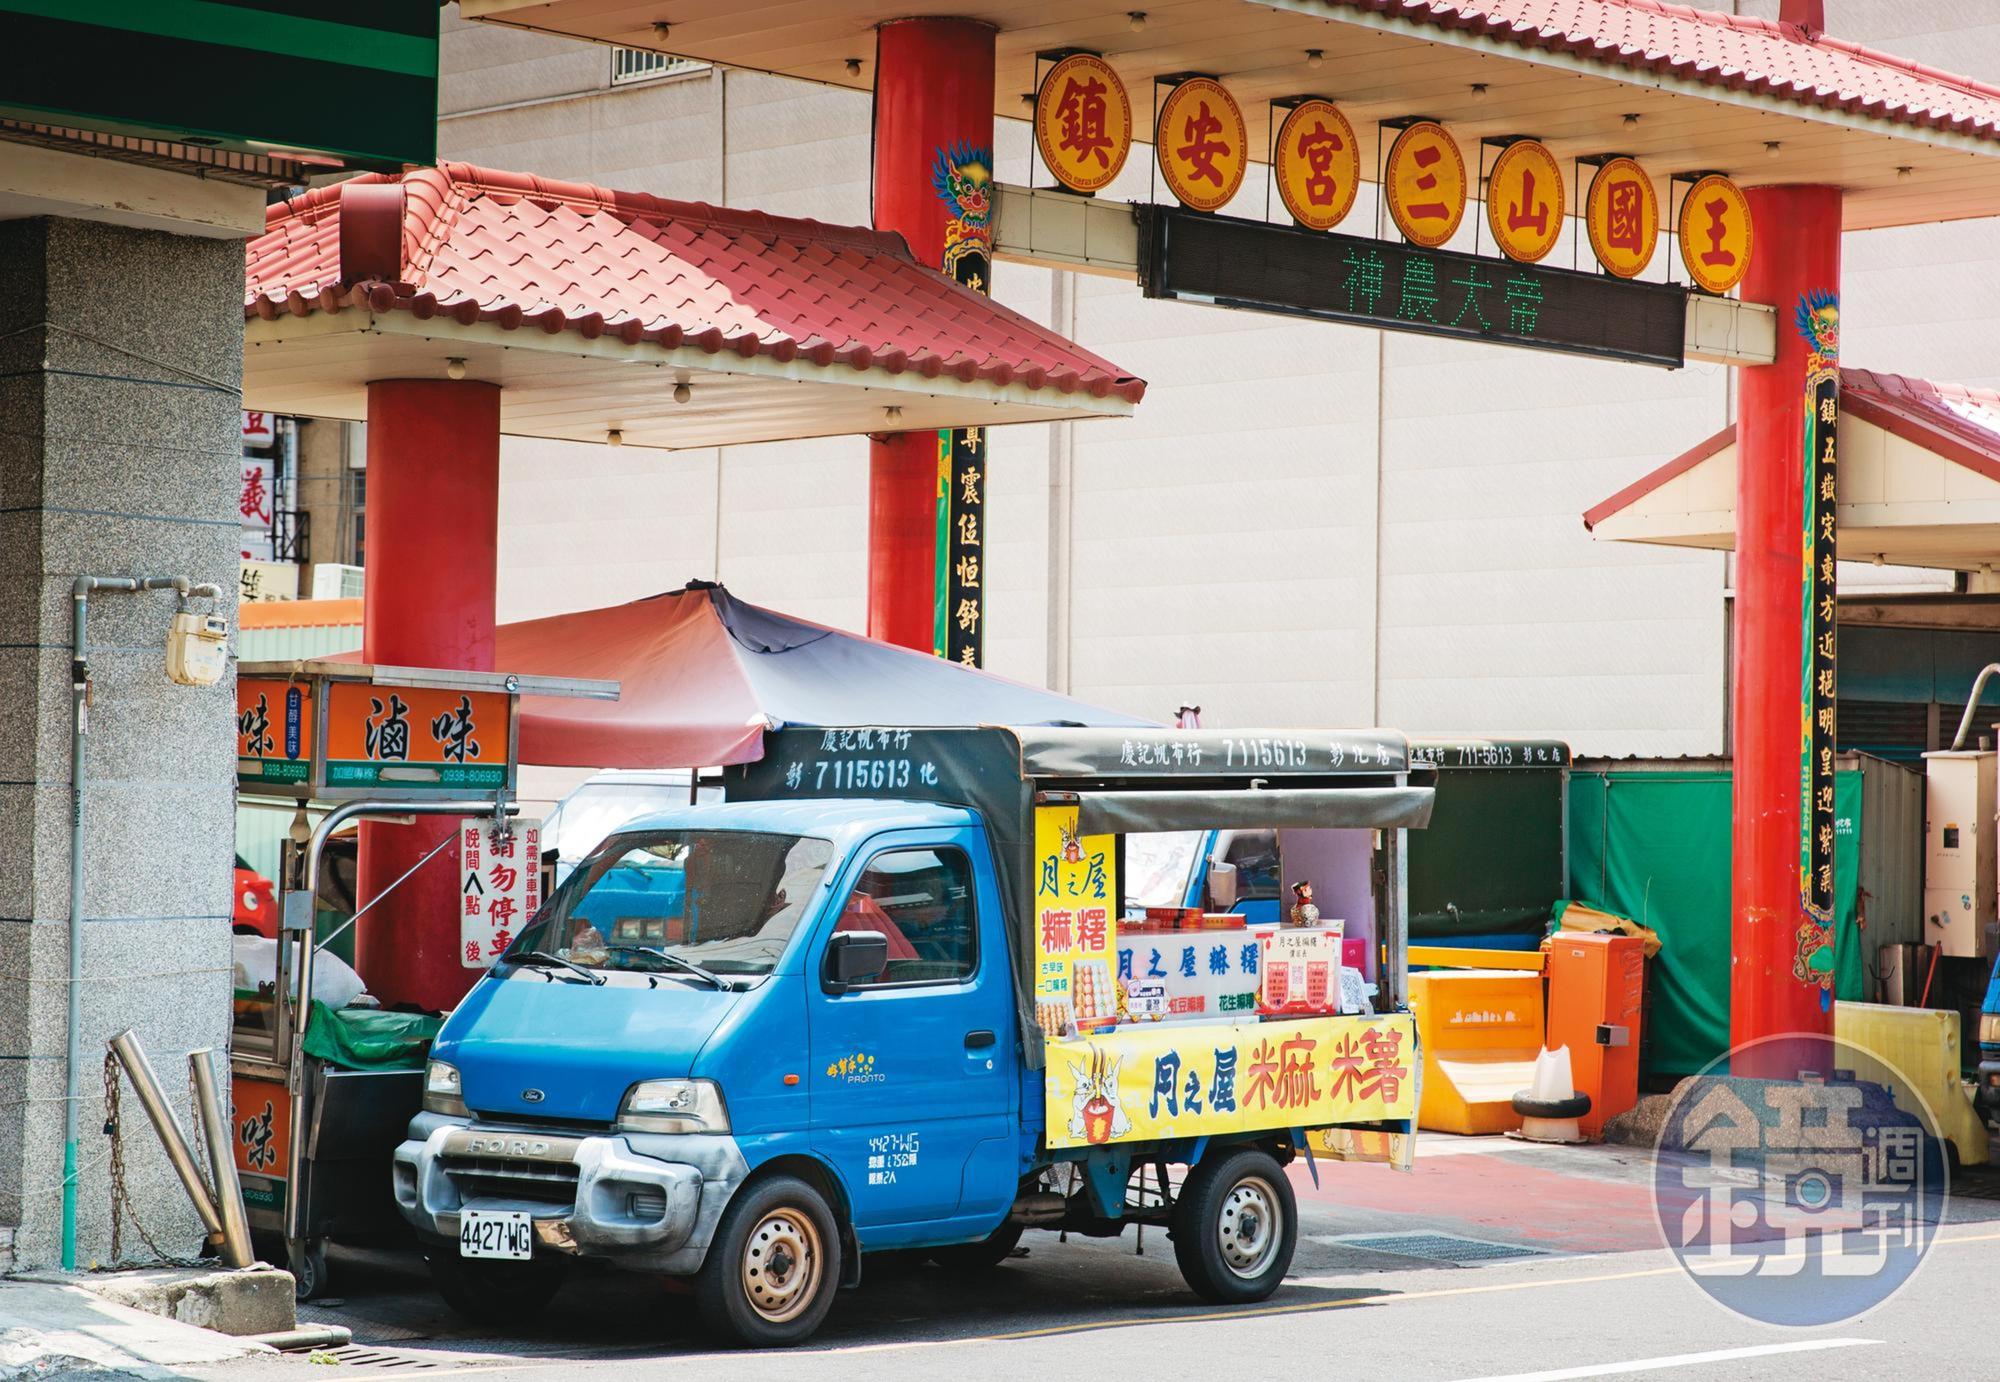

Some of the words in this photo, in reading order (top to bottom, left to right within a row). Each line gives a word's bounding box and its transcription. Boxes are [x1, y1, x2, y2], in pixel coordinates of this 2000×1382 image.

[1055, 76, 1736, 267] 鎮安宮三山國王
[1342, 247, 1544, 335] 神農大帝
[366, 694, 479, 763] 滷味
[820, 728, 912, 752] 慶記帆布行
[1120, 739, 1201, 767] 慶記帆布行
[1223, 738, 1307, 767] 7115613
[1457, 746, 1513, 765] 711-5613
[442, 770, 502, 783] 0938-806930
[815, 759, 911, 790] 7115613
[1039, 853, 1107, 899] 月之屋
[487, 828, 518, 956] 請勿停車
[847, 1074, 886, 1084] PRONTO
[466, 1138, 550, 1155] FORD
[868, 1132, 919, 1152] 4427-WG
